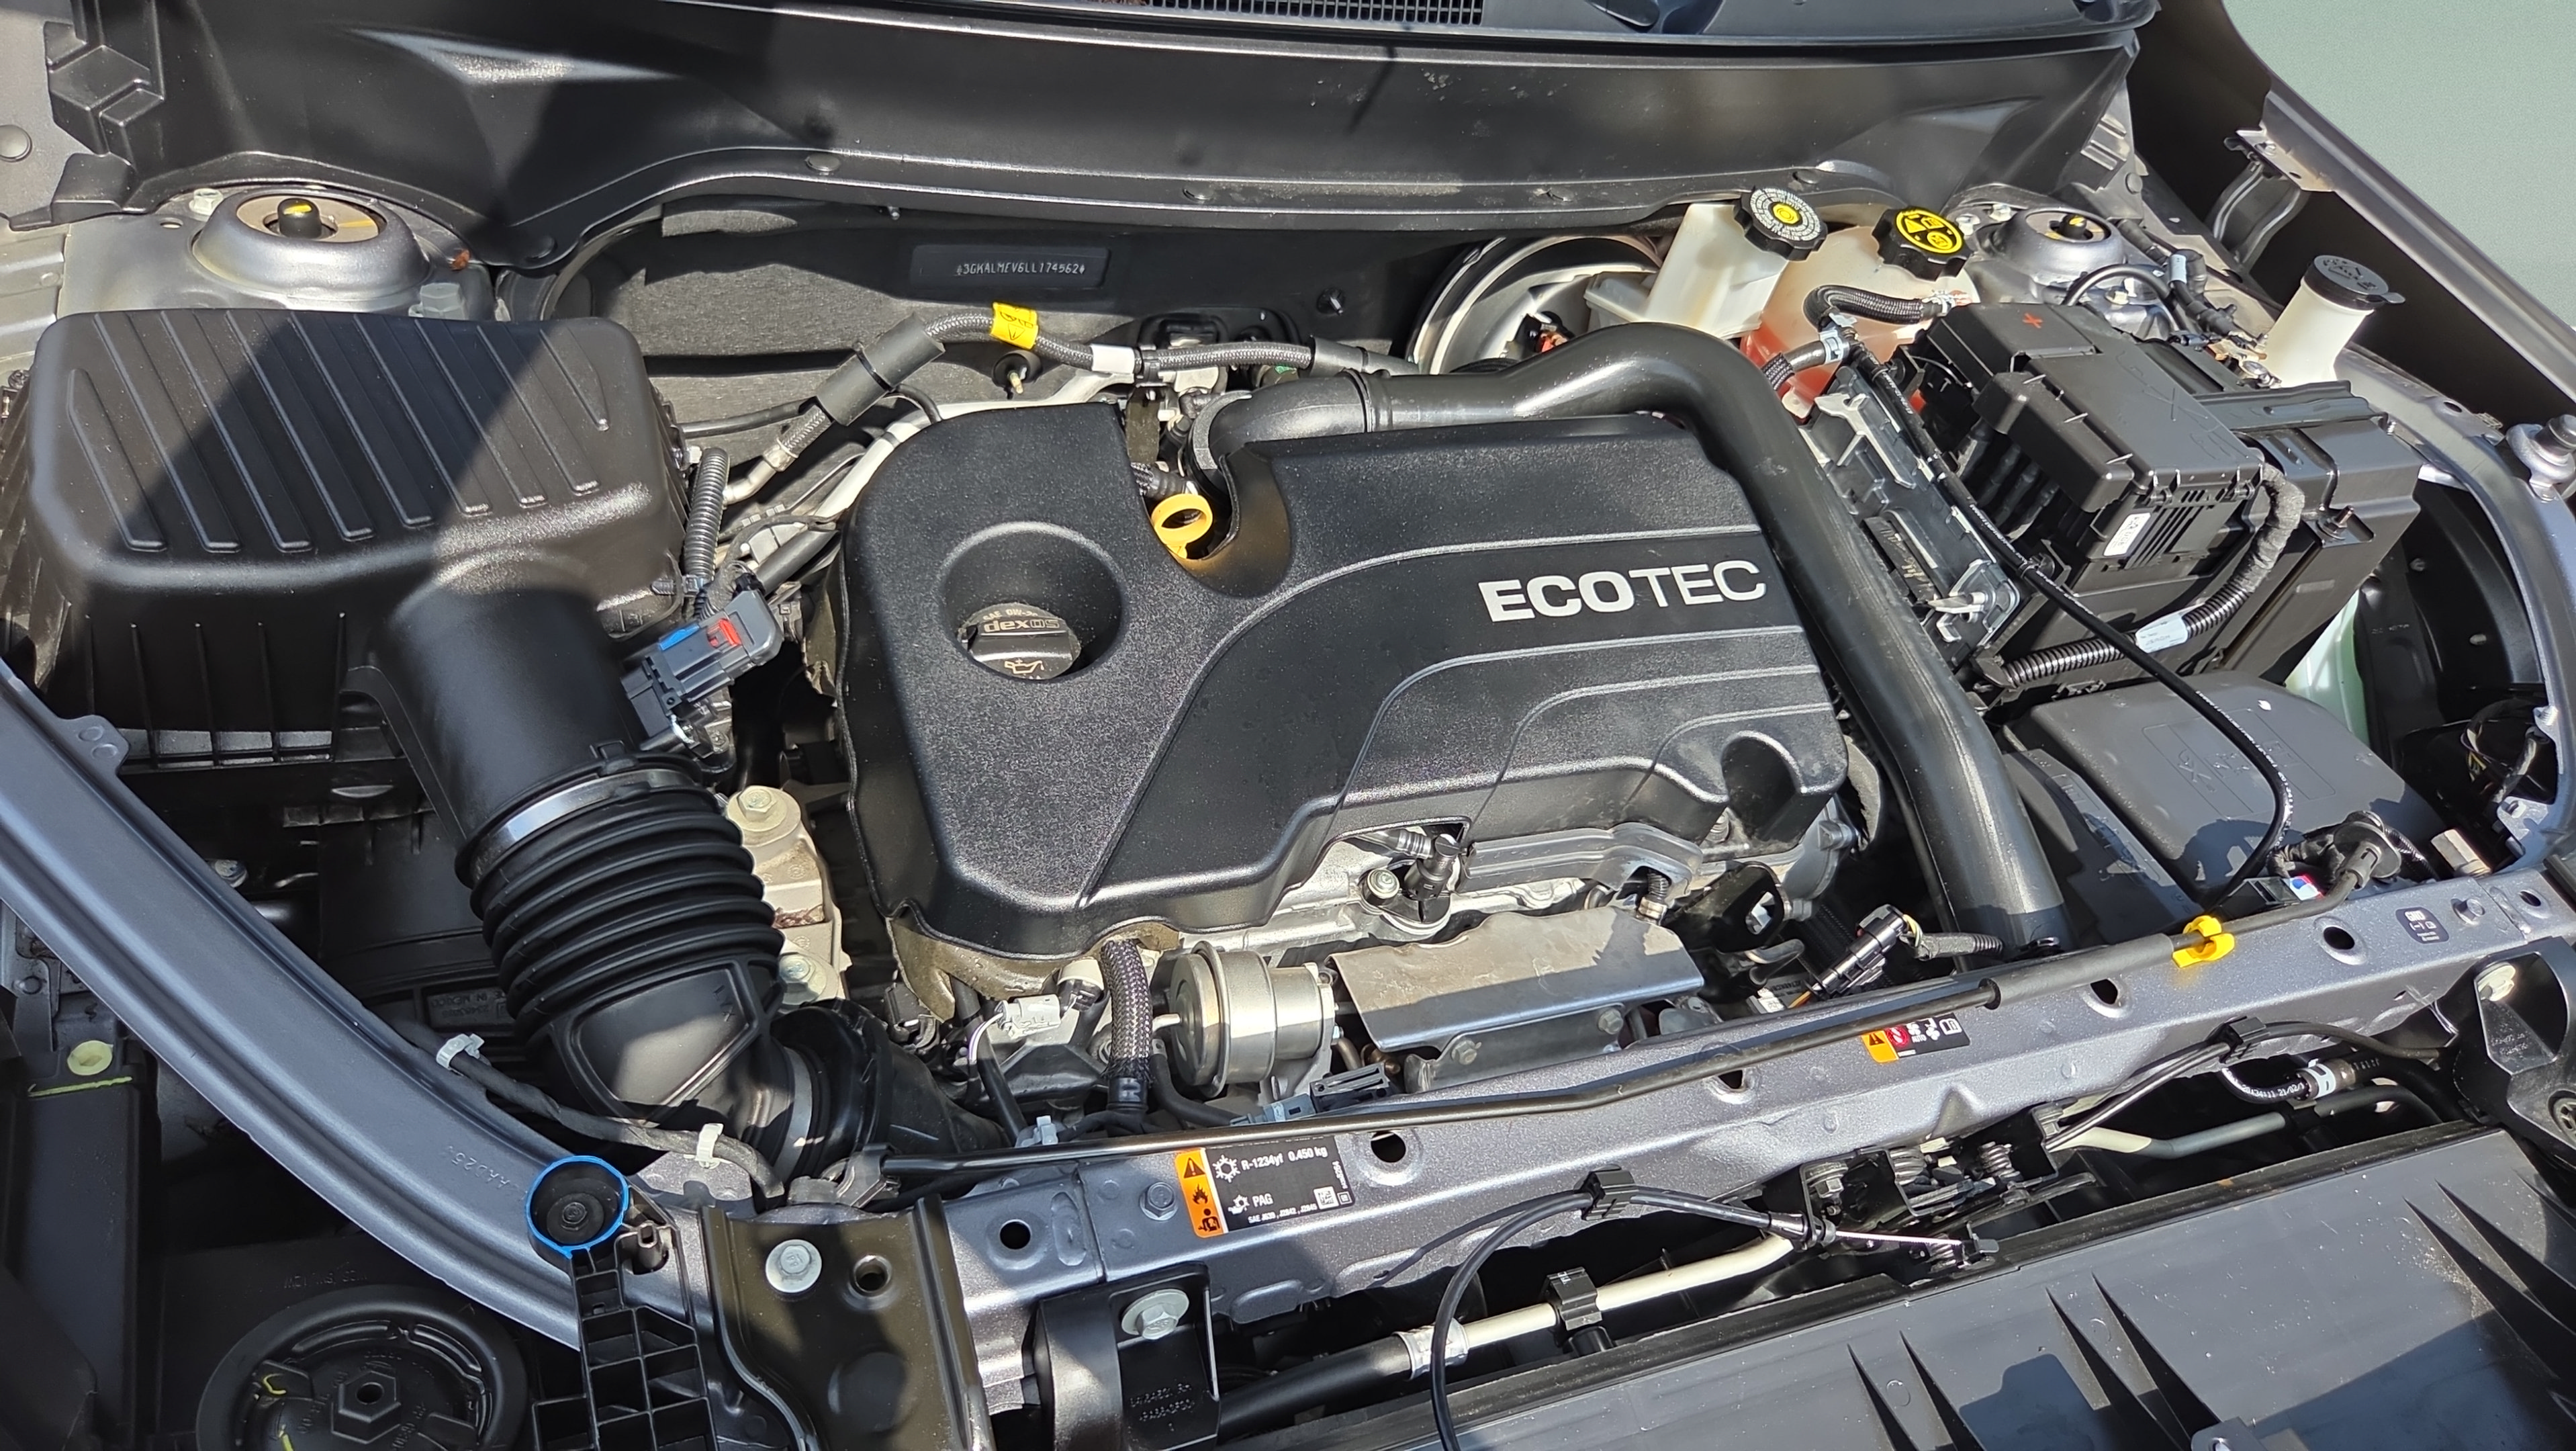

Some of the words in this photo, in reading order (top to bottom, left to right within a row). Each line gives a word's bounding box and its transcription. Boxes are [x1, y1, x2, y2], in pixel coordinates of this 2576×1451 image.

[962, 263, 1078, 275] 3GKALMEV6LL174562
[1478, 560, 1767, 622] ECOTEC
[983, 610, 1002, 621] SAE
[983, 618, 1060, 633] dexos
[2405, 910, 2426, 922] GND
[1241, 1153, 1284, 1172] R-1234yf
[1287, 1147, 1314, 1162] 0.450
[1315, 1146, 1328, 1157] kg
[1252, 1193, 1273, 1207] PAG
[1248, 1214, 1260, 1224] SAE
